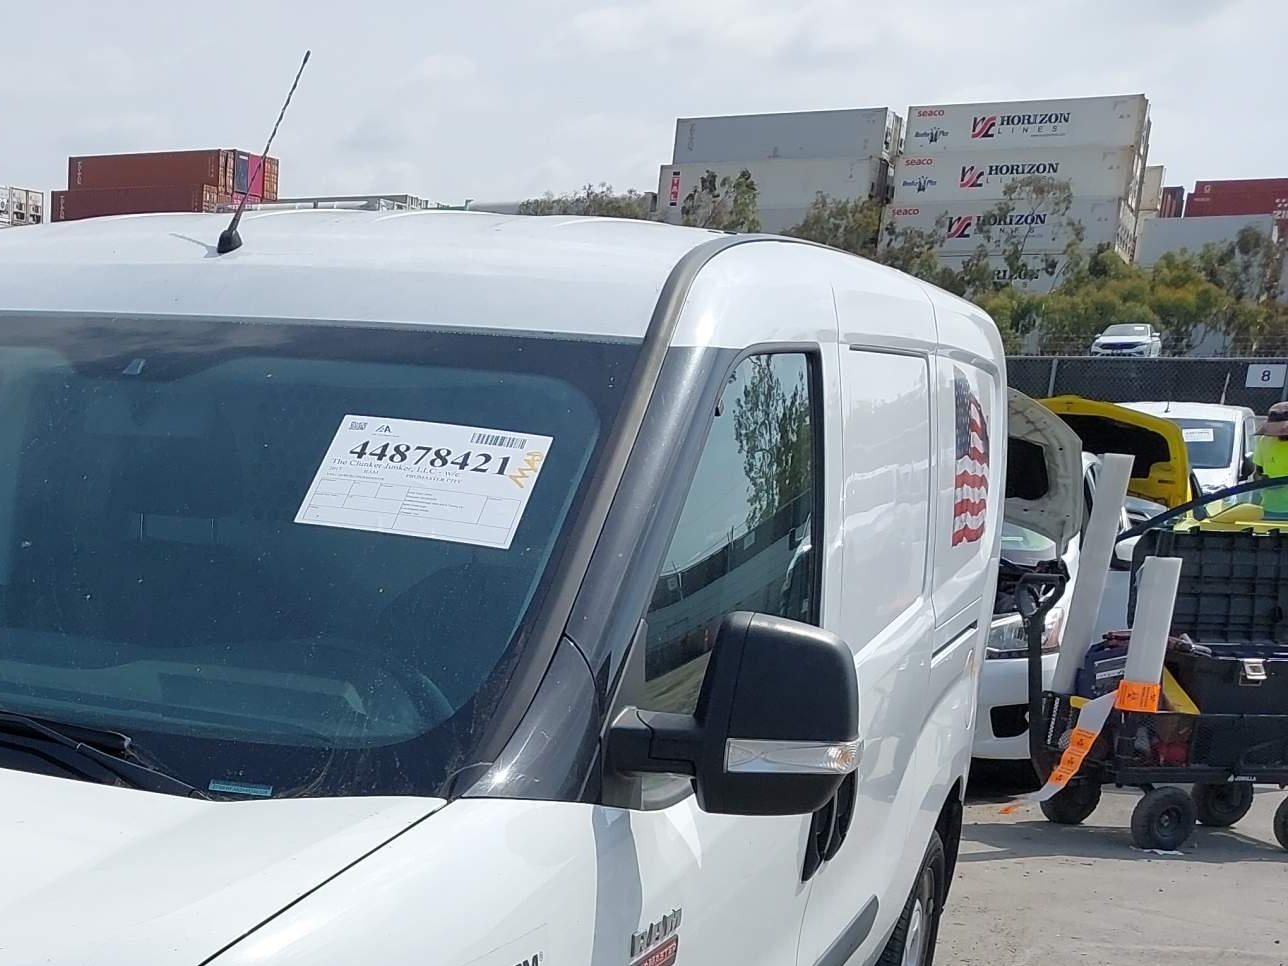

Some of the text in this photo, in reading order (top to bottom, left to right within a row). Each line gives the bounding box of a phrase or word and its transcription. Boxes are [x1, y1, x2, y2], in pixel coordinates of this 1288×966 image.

[917, 109, 945, 117] seaco
[999, 112, 1071, 126] HORIZON
[998, 126, 1058, 135] LINES
[904, 158, 933, 166] seaco
[988, 162, 1059, 176] HORIZON
[891, 208, 920, 216] seaco
[1261, 370, 1271, 381] 8
[332, 457, 348, 466] The
[348, 440, 512, 476] 44878421
[630, 907, 682, 958] RAM
